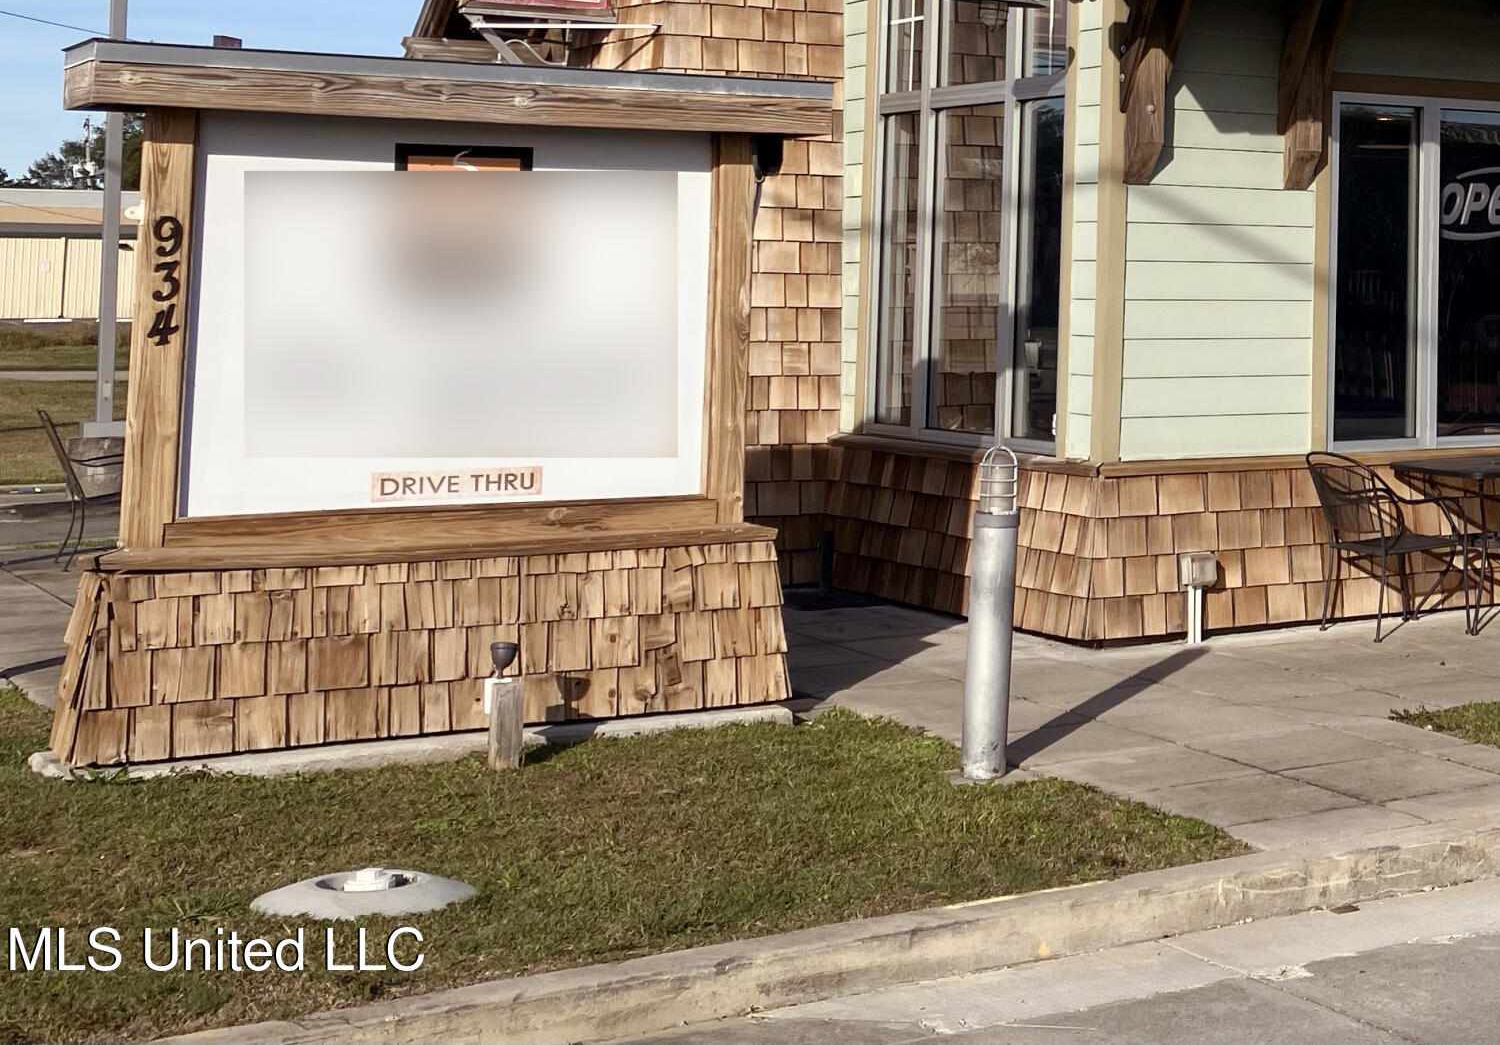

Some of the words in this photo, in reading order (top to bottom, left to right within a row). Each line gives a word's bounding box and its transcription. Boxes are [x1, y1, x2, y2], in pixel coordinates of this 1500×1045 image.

[147, 215, 183, 346] 934
[380, 475, 460, 496] DRIVE
[470, 472, 535, 492] THRU
